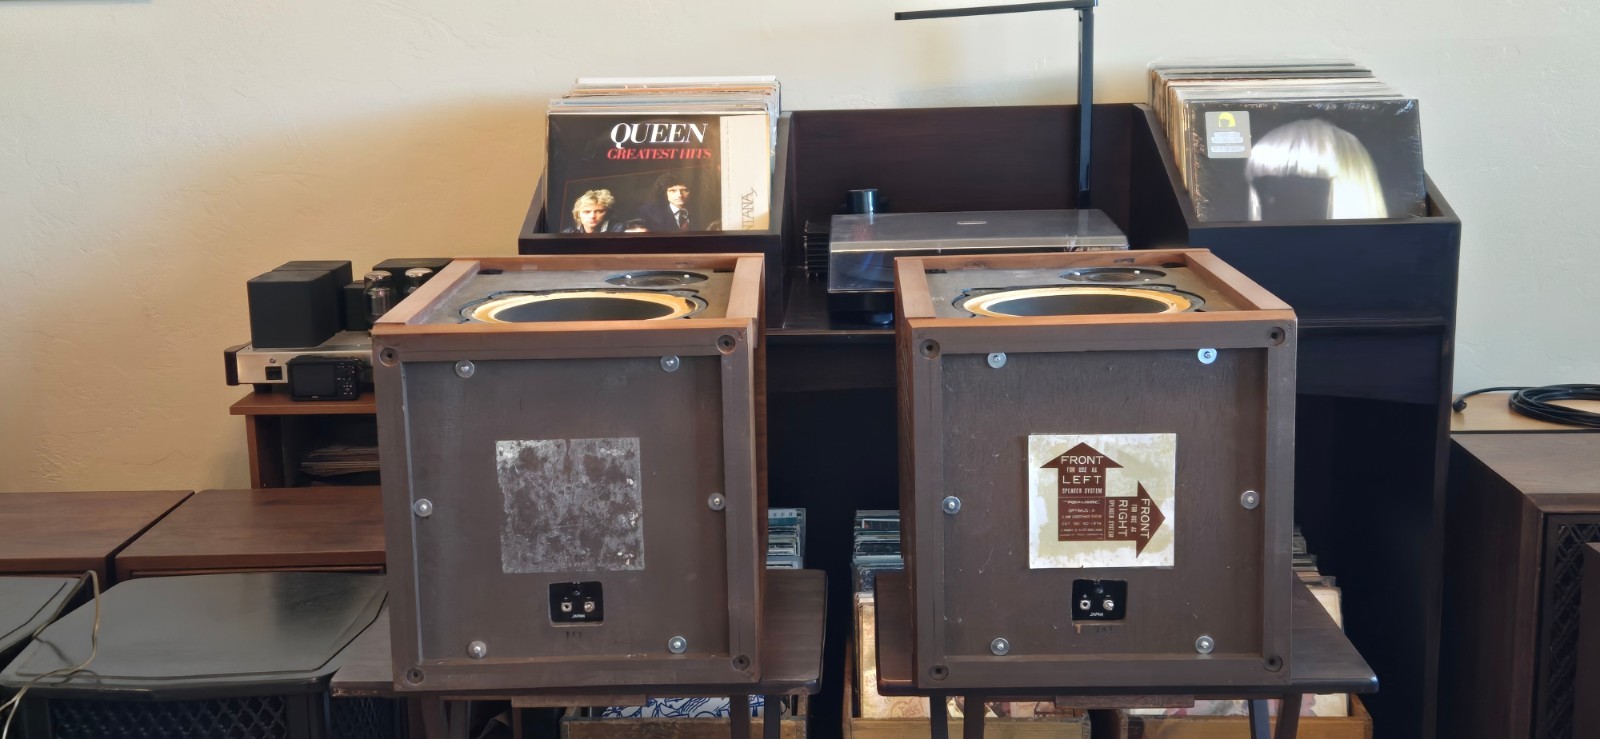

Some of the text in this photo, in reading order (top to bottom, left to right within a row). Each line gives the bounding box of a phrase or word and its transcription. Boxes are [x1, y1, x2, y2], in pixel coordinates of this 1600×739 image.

[610, 122, 708, 148] QUEEN
[607, 148, 712, 160] GREATEST HITS
[1060, 455, 1104, 465] FRONT
[1062, 475, 1102, 484] LEFT
[1117, 499, 1129, 538] RIGHT
[1140, 498, 1151, 540] FRONT
